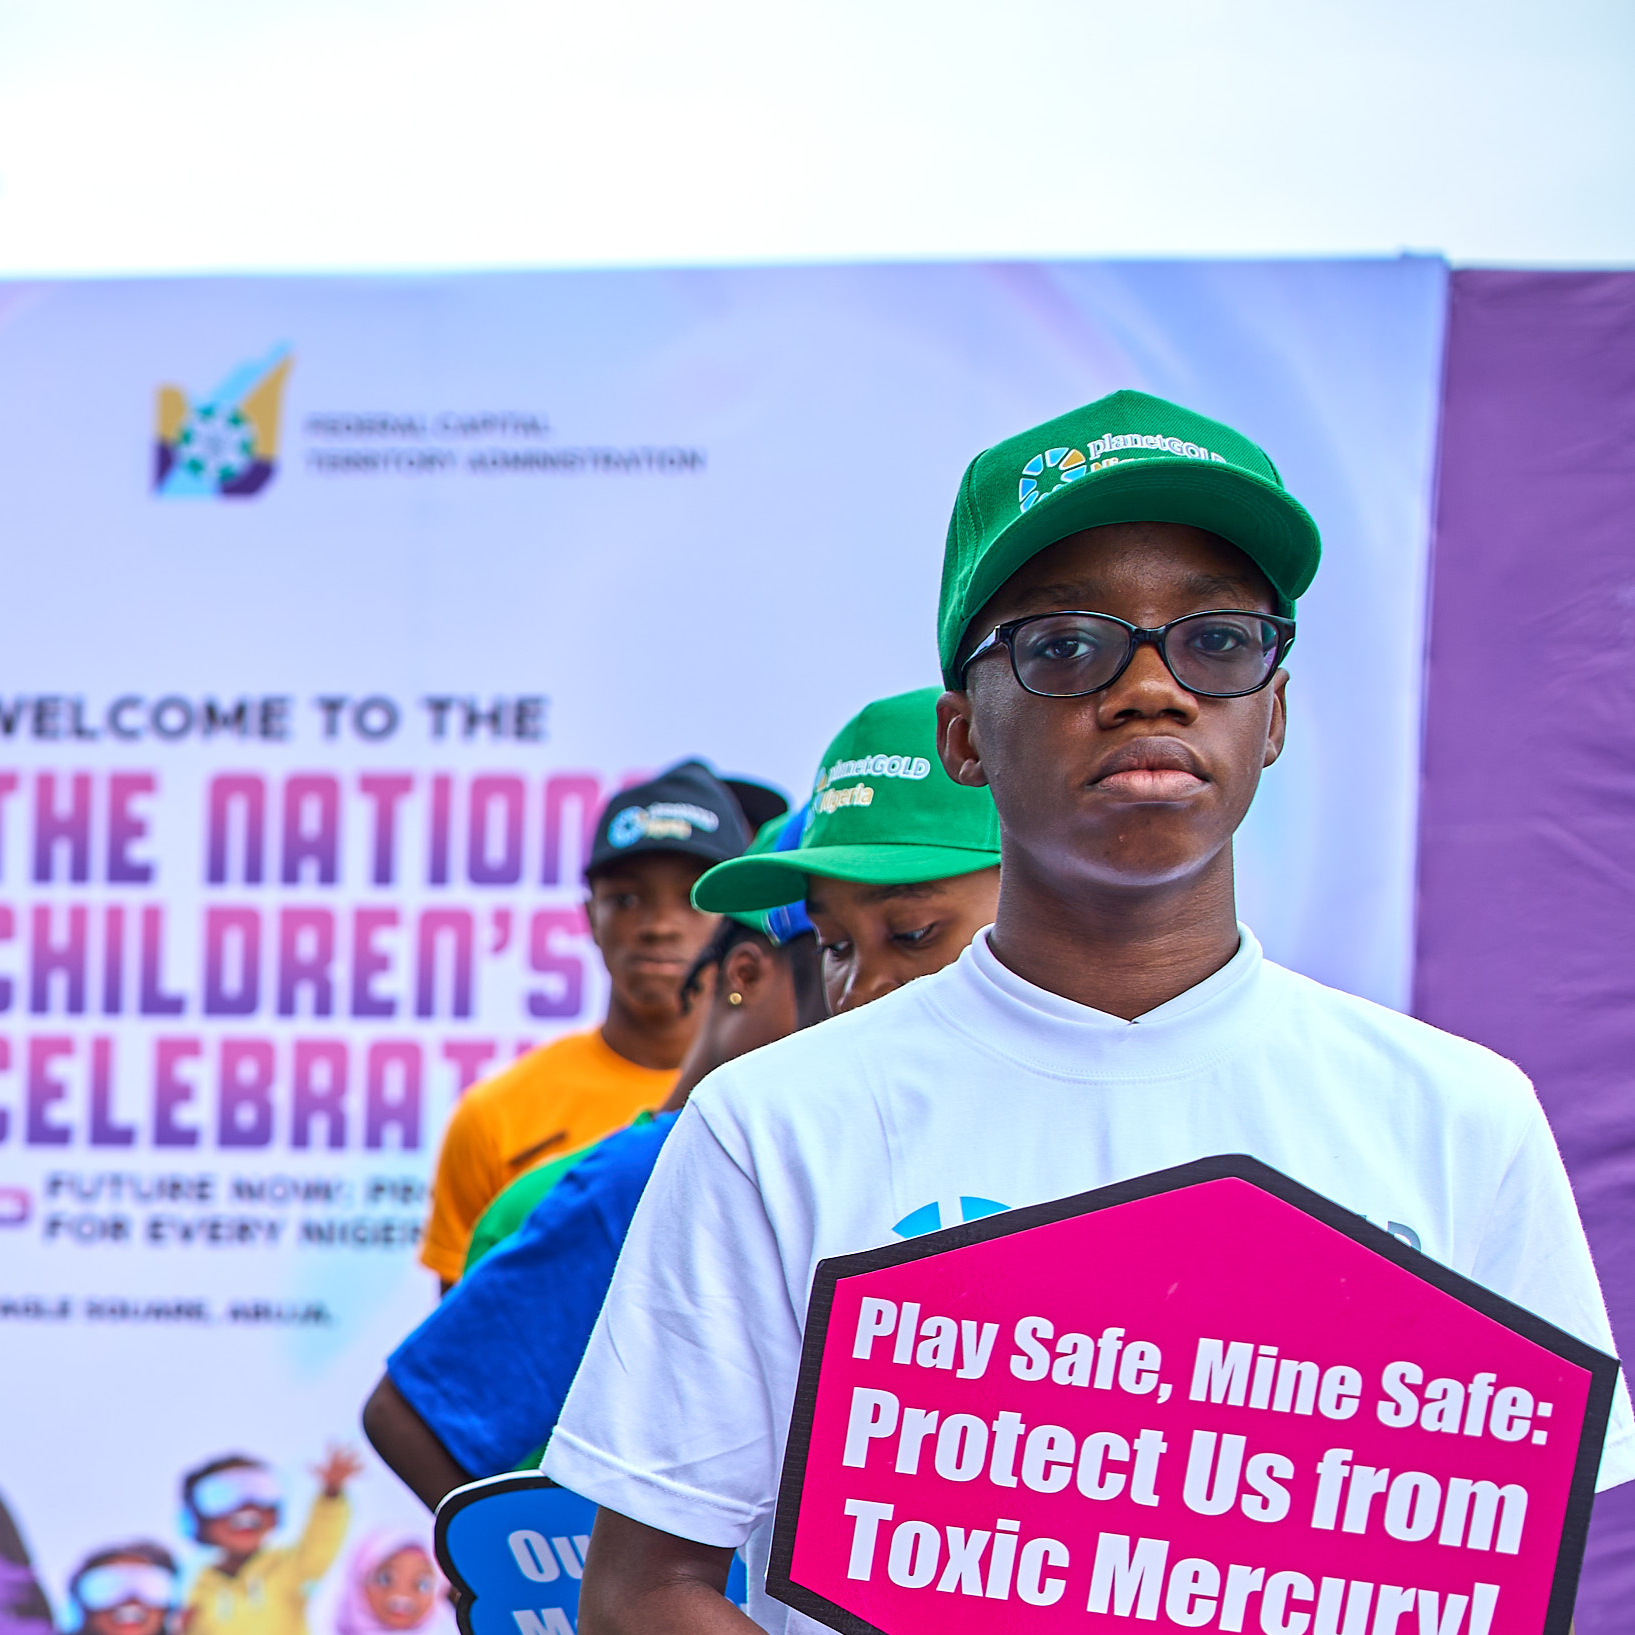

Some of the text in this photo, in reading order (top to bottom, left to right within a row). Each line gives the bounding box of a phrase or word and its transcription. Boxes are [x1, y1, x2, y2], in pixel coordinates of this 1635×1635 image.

[310, 696, 399, 741] TO
[419, 697, 549, 741] THE
[205, 773, 654, 888] NATION
[45, 1174, 213, 1202] FUTURE
[44, 1215, 128, 1244] FOR
[148, 1216, 281, 1245] EVERY
[851, 1296, 1554, 1445] Play Safe, Mine Safe:
[841, 1386, 1529, 1555] Protect Us from
[507, 1529, 592, 1583] Ou
[843, 1498, 1071, 1608] Toxic
